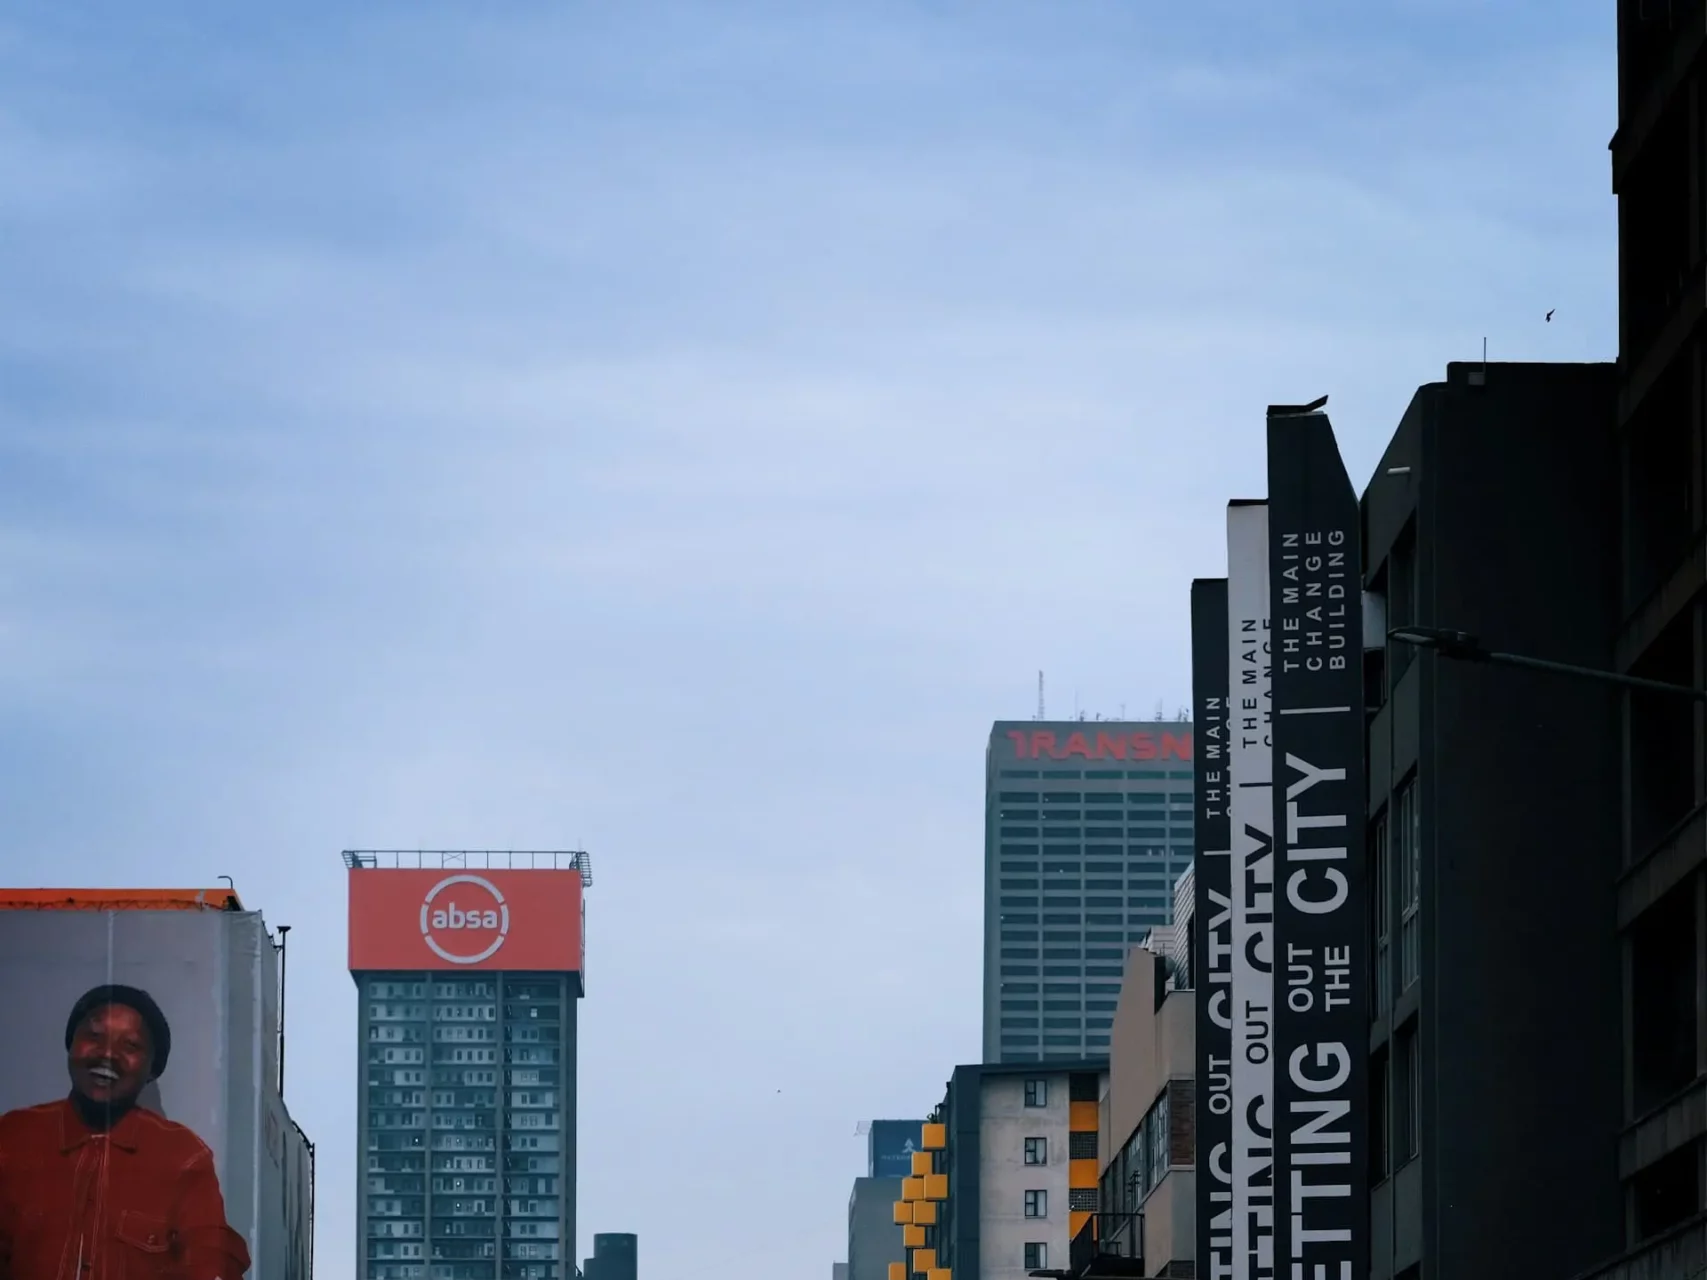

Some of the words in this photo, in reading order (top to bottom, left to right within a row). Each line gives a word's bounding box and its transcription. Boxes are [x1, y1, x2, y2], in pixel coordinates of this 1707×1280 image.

[1282, 533, 1300, 604] MAIN
[1328, 530, 1347, 670] BUILDING
[1305, 531, 1323, 671] CHANGE
[1242, 620, 1257, 684] MAIN
[1283, 618, 1300, 673] THE
[1206, 698, 1221, 759] MAIN
[1243, 698, 1257, 748] THE
[1206, 771, 1221, 819] THE
[1286, 752, 1350, 915] CITY
[432, 902, 499, 930] absa
[1288, 943, 1315, 1013] OUT
[1325, 945, 1351, 1012] THE
[1246, 1001, 1269, 1064] OUT
[1208, 1054, 1232, 1115] OUT
